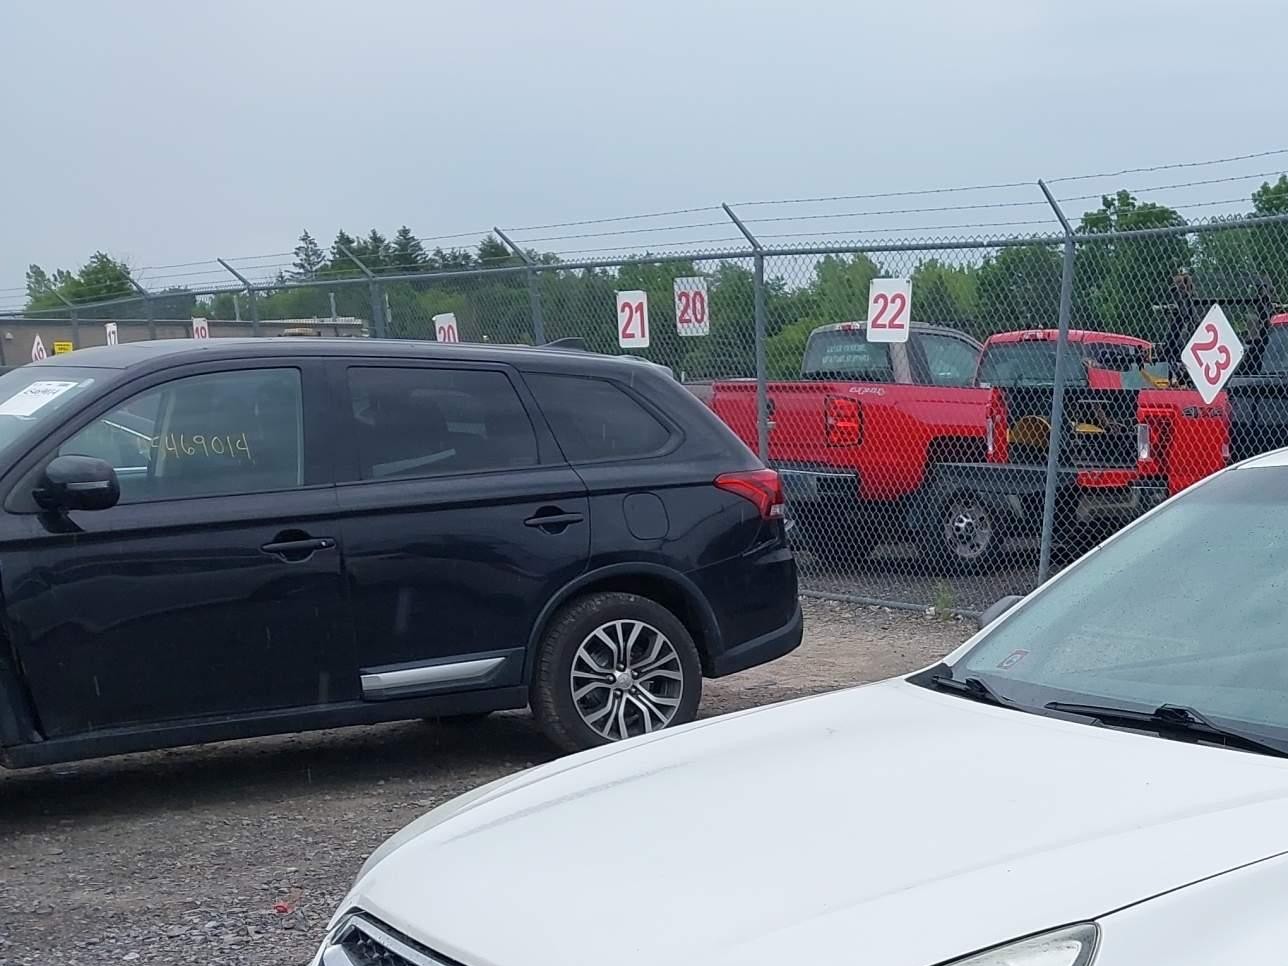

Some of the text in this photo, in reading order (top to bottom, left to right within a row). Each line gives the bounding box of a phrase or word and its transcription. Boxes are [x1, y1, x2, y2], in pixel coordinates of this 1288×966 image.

[619, 301, 646, 339] 21
[677, 289, 706, 324] 20
[871, 293, 906, 329] 22
[1190, 323, 1231, 385] 23
